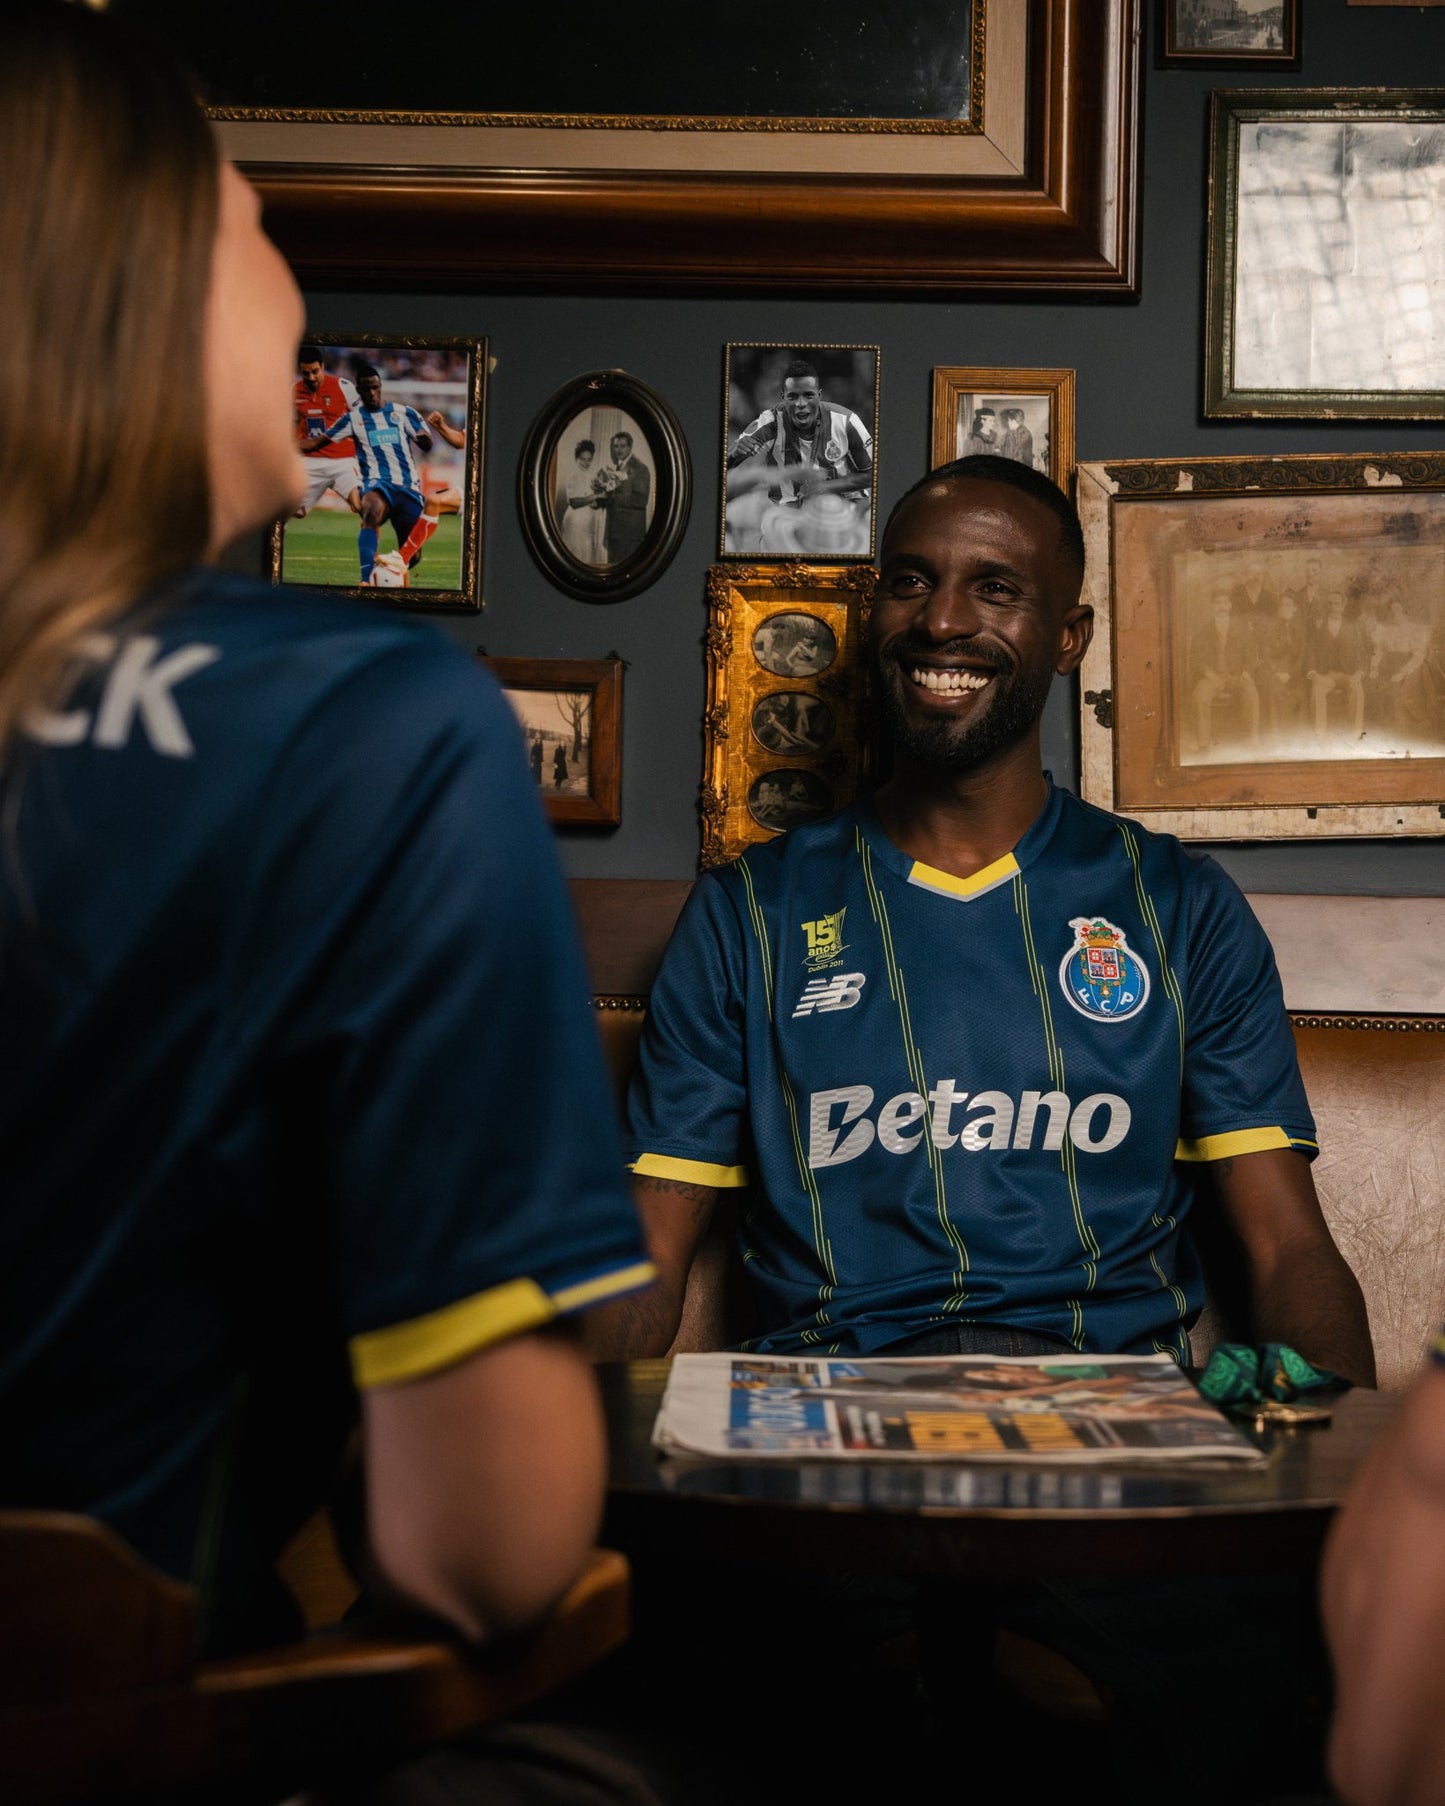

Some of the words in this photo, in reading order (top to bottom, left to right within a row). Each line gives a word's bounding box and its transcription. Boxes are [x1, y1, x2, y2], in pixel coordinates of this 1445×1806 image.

[801, 916, 836, 948] 15
[808, 943, 837, 957] anos
[829, 959, 844, 969] 2011
[808, 1079, 1132, 1169] Betano
